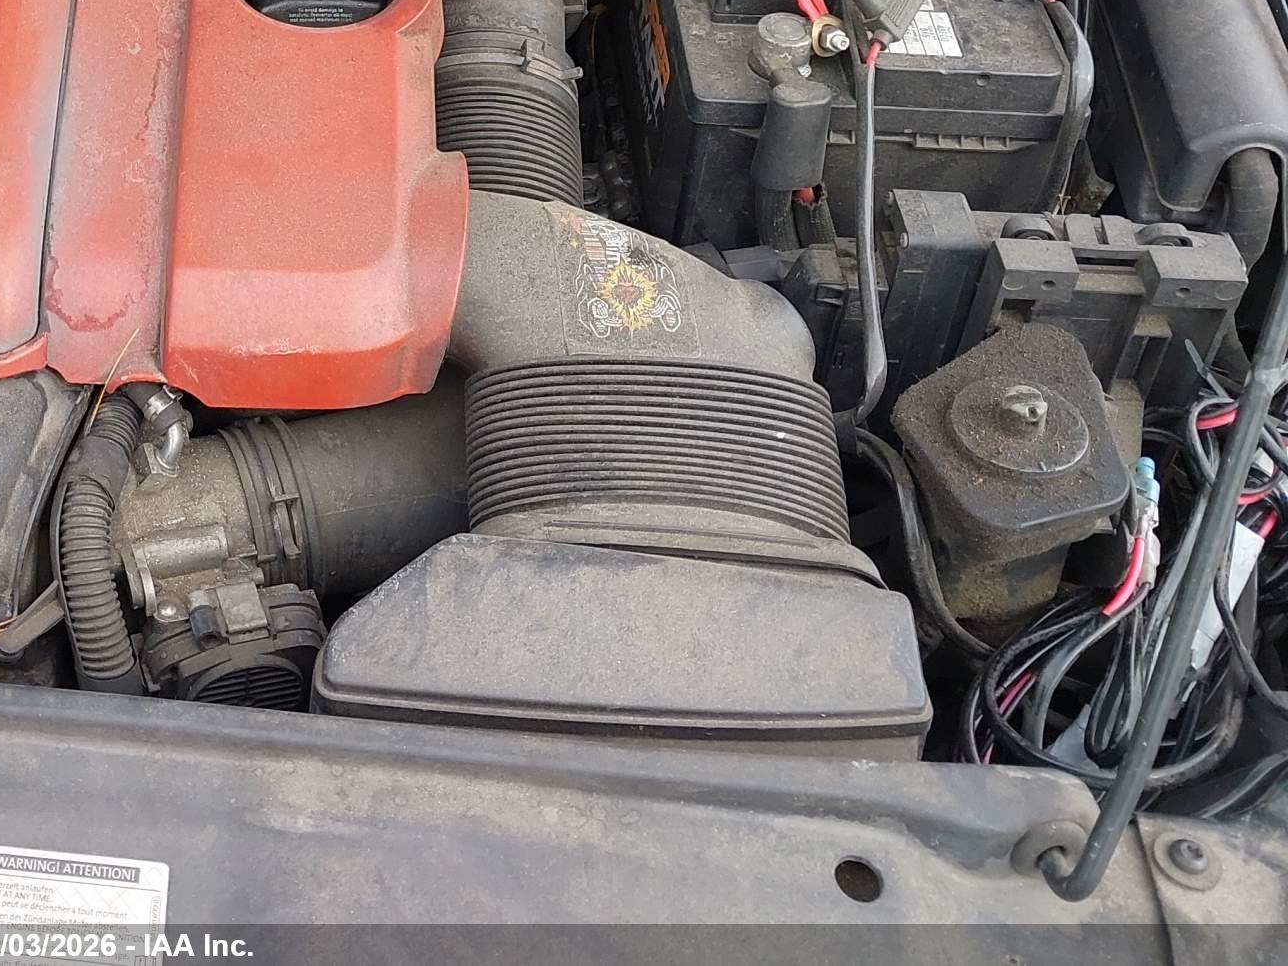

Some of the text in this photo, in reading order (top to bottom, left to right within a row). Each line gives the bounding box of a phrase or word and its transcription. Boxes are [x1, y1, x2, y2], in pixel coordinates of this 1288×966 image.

[62, 864, 137, 882] ATTENTION!
[14, 892, 30, 900] ANY
[2, 900, 18, 909] peut
[7, 922, 36, 932] ENGINE
